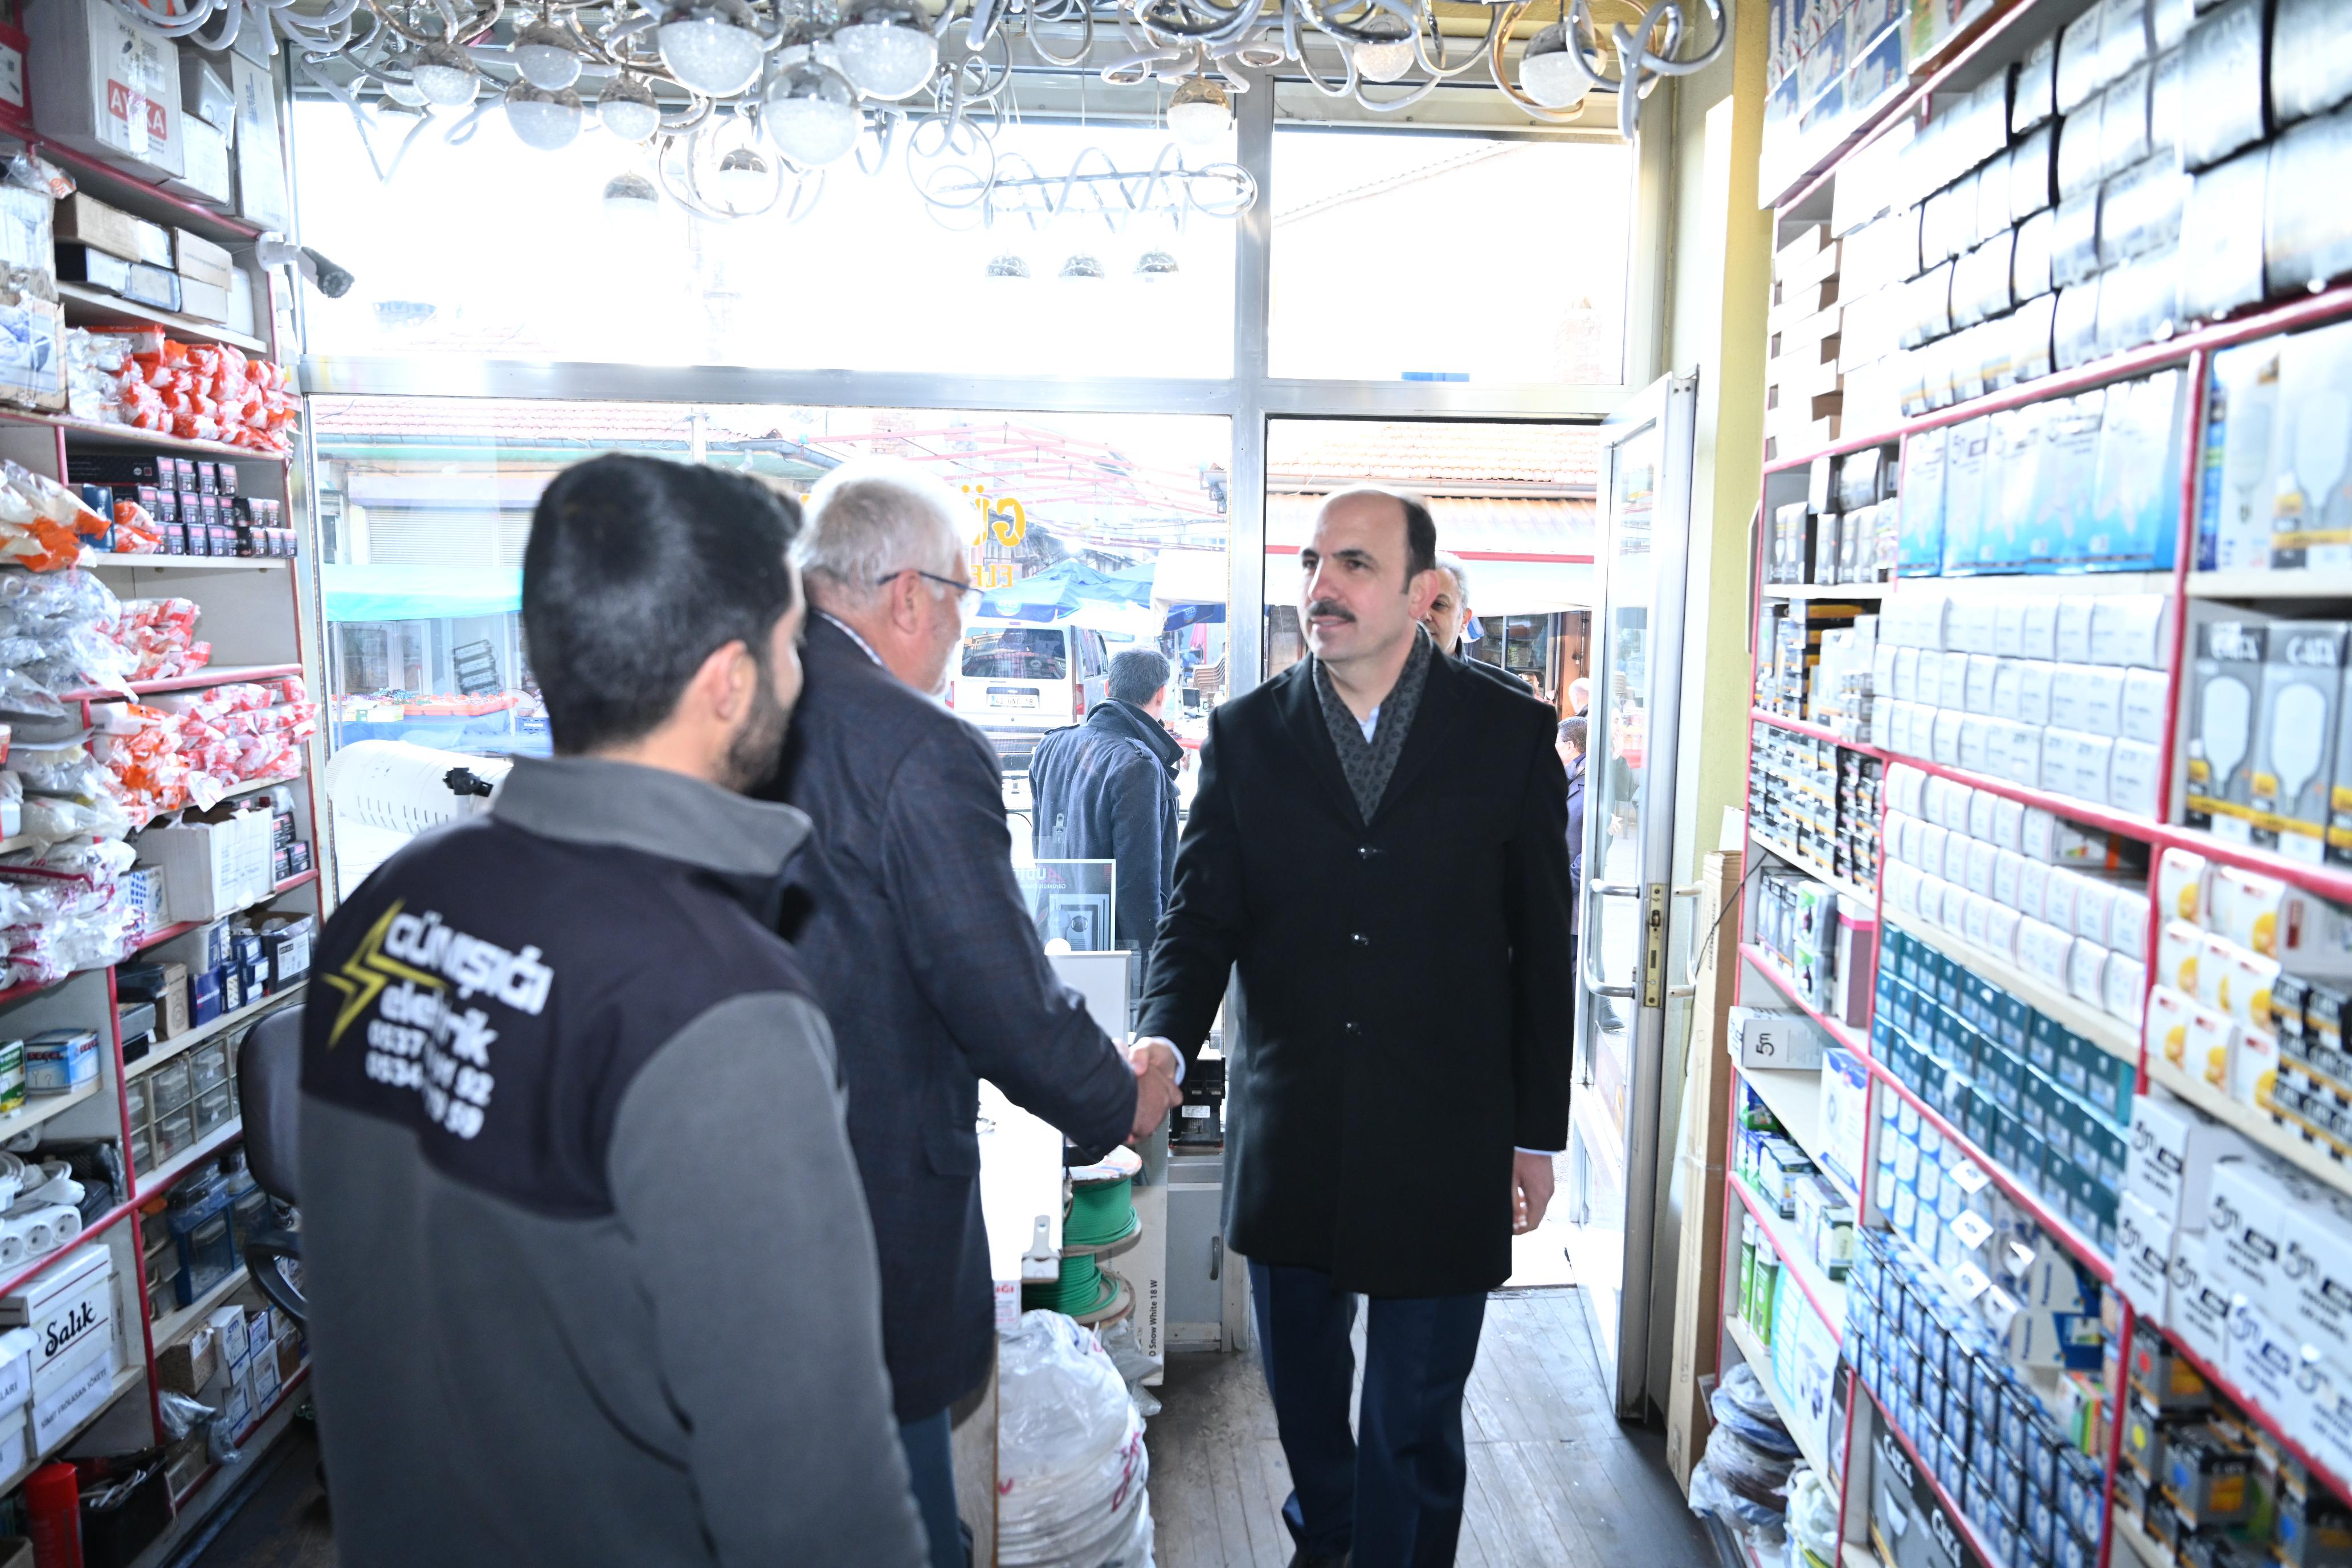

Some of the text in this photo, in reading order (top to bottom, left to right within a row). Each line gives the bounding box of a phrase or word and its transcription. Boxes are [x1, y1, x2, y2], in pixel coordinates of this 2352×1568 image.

[1150, 1279, 1158, 1288] W
[1150, 1289, 1158, 1300] 18
[1149, 1301, 1158, 1326] White
